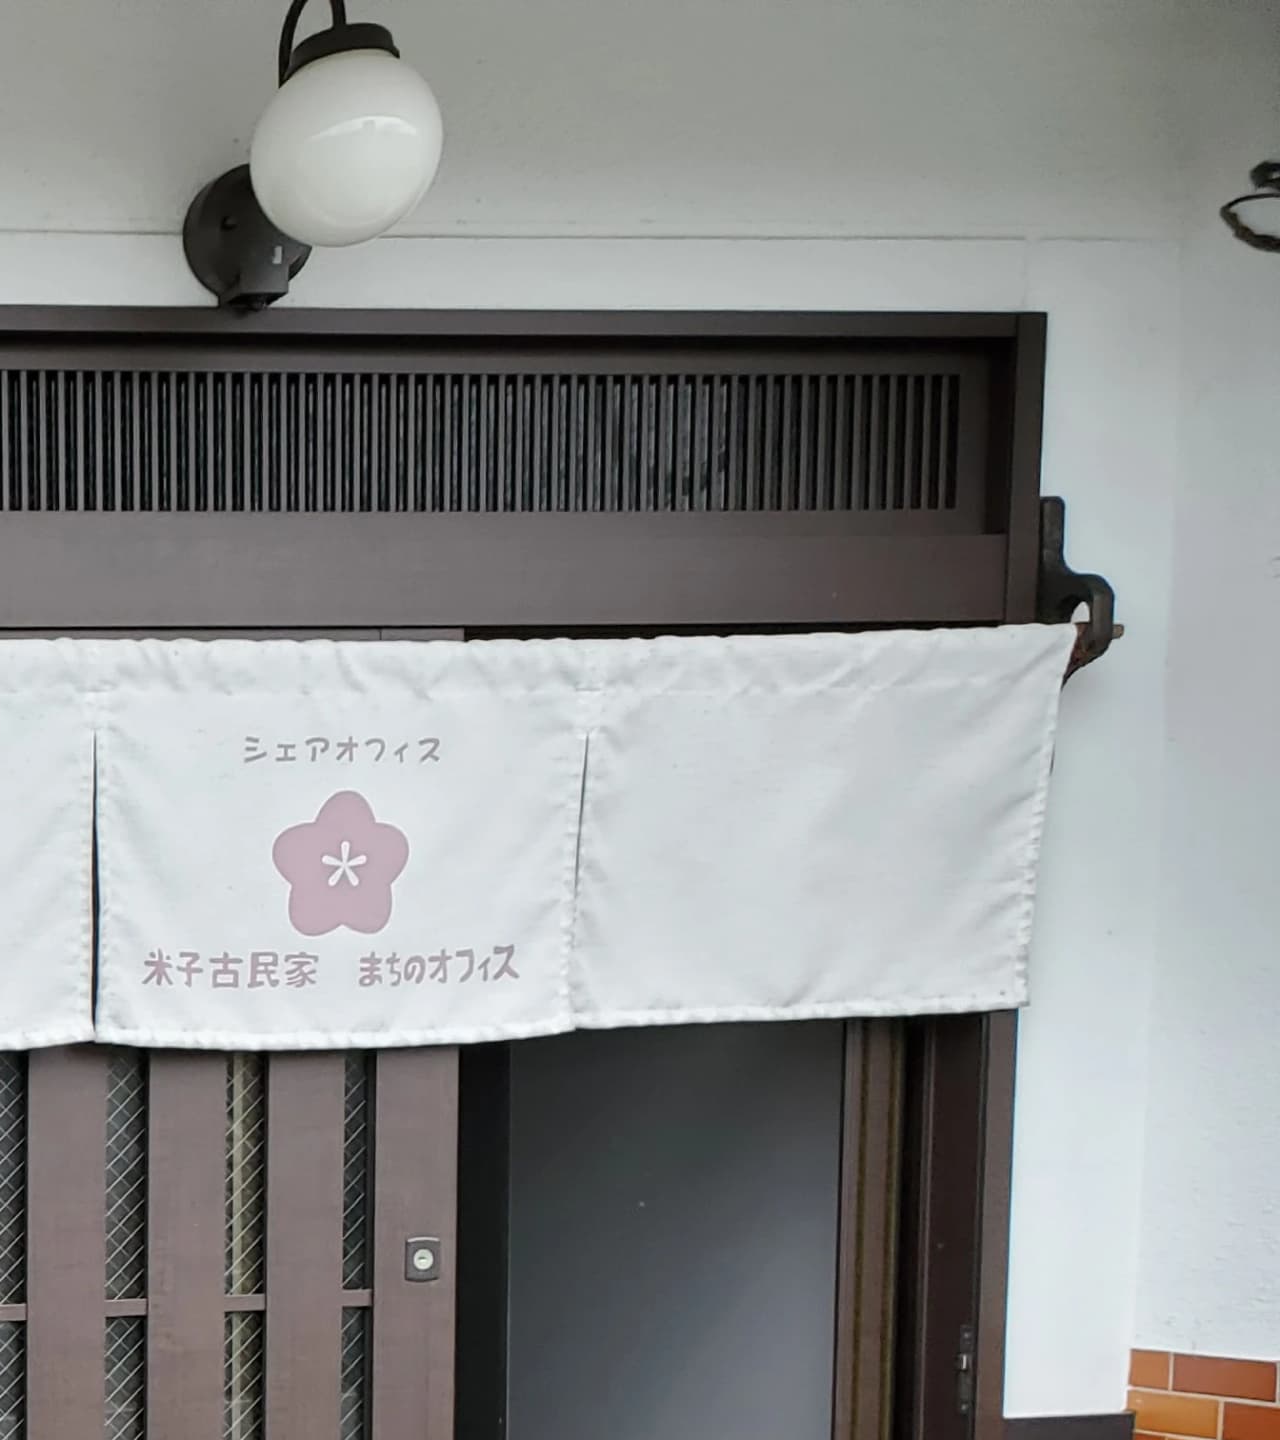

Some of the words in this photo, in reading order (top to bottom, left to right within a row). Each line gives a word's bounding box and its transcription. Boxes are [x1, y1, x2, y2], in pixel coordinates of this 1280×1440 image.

[242, 735, 442, 764] シェアオフィス
[141, 947, 320, 989] 米子古民家
[357, 944, 521, 987] まちのオフィス
